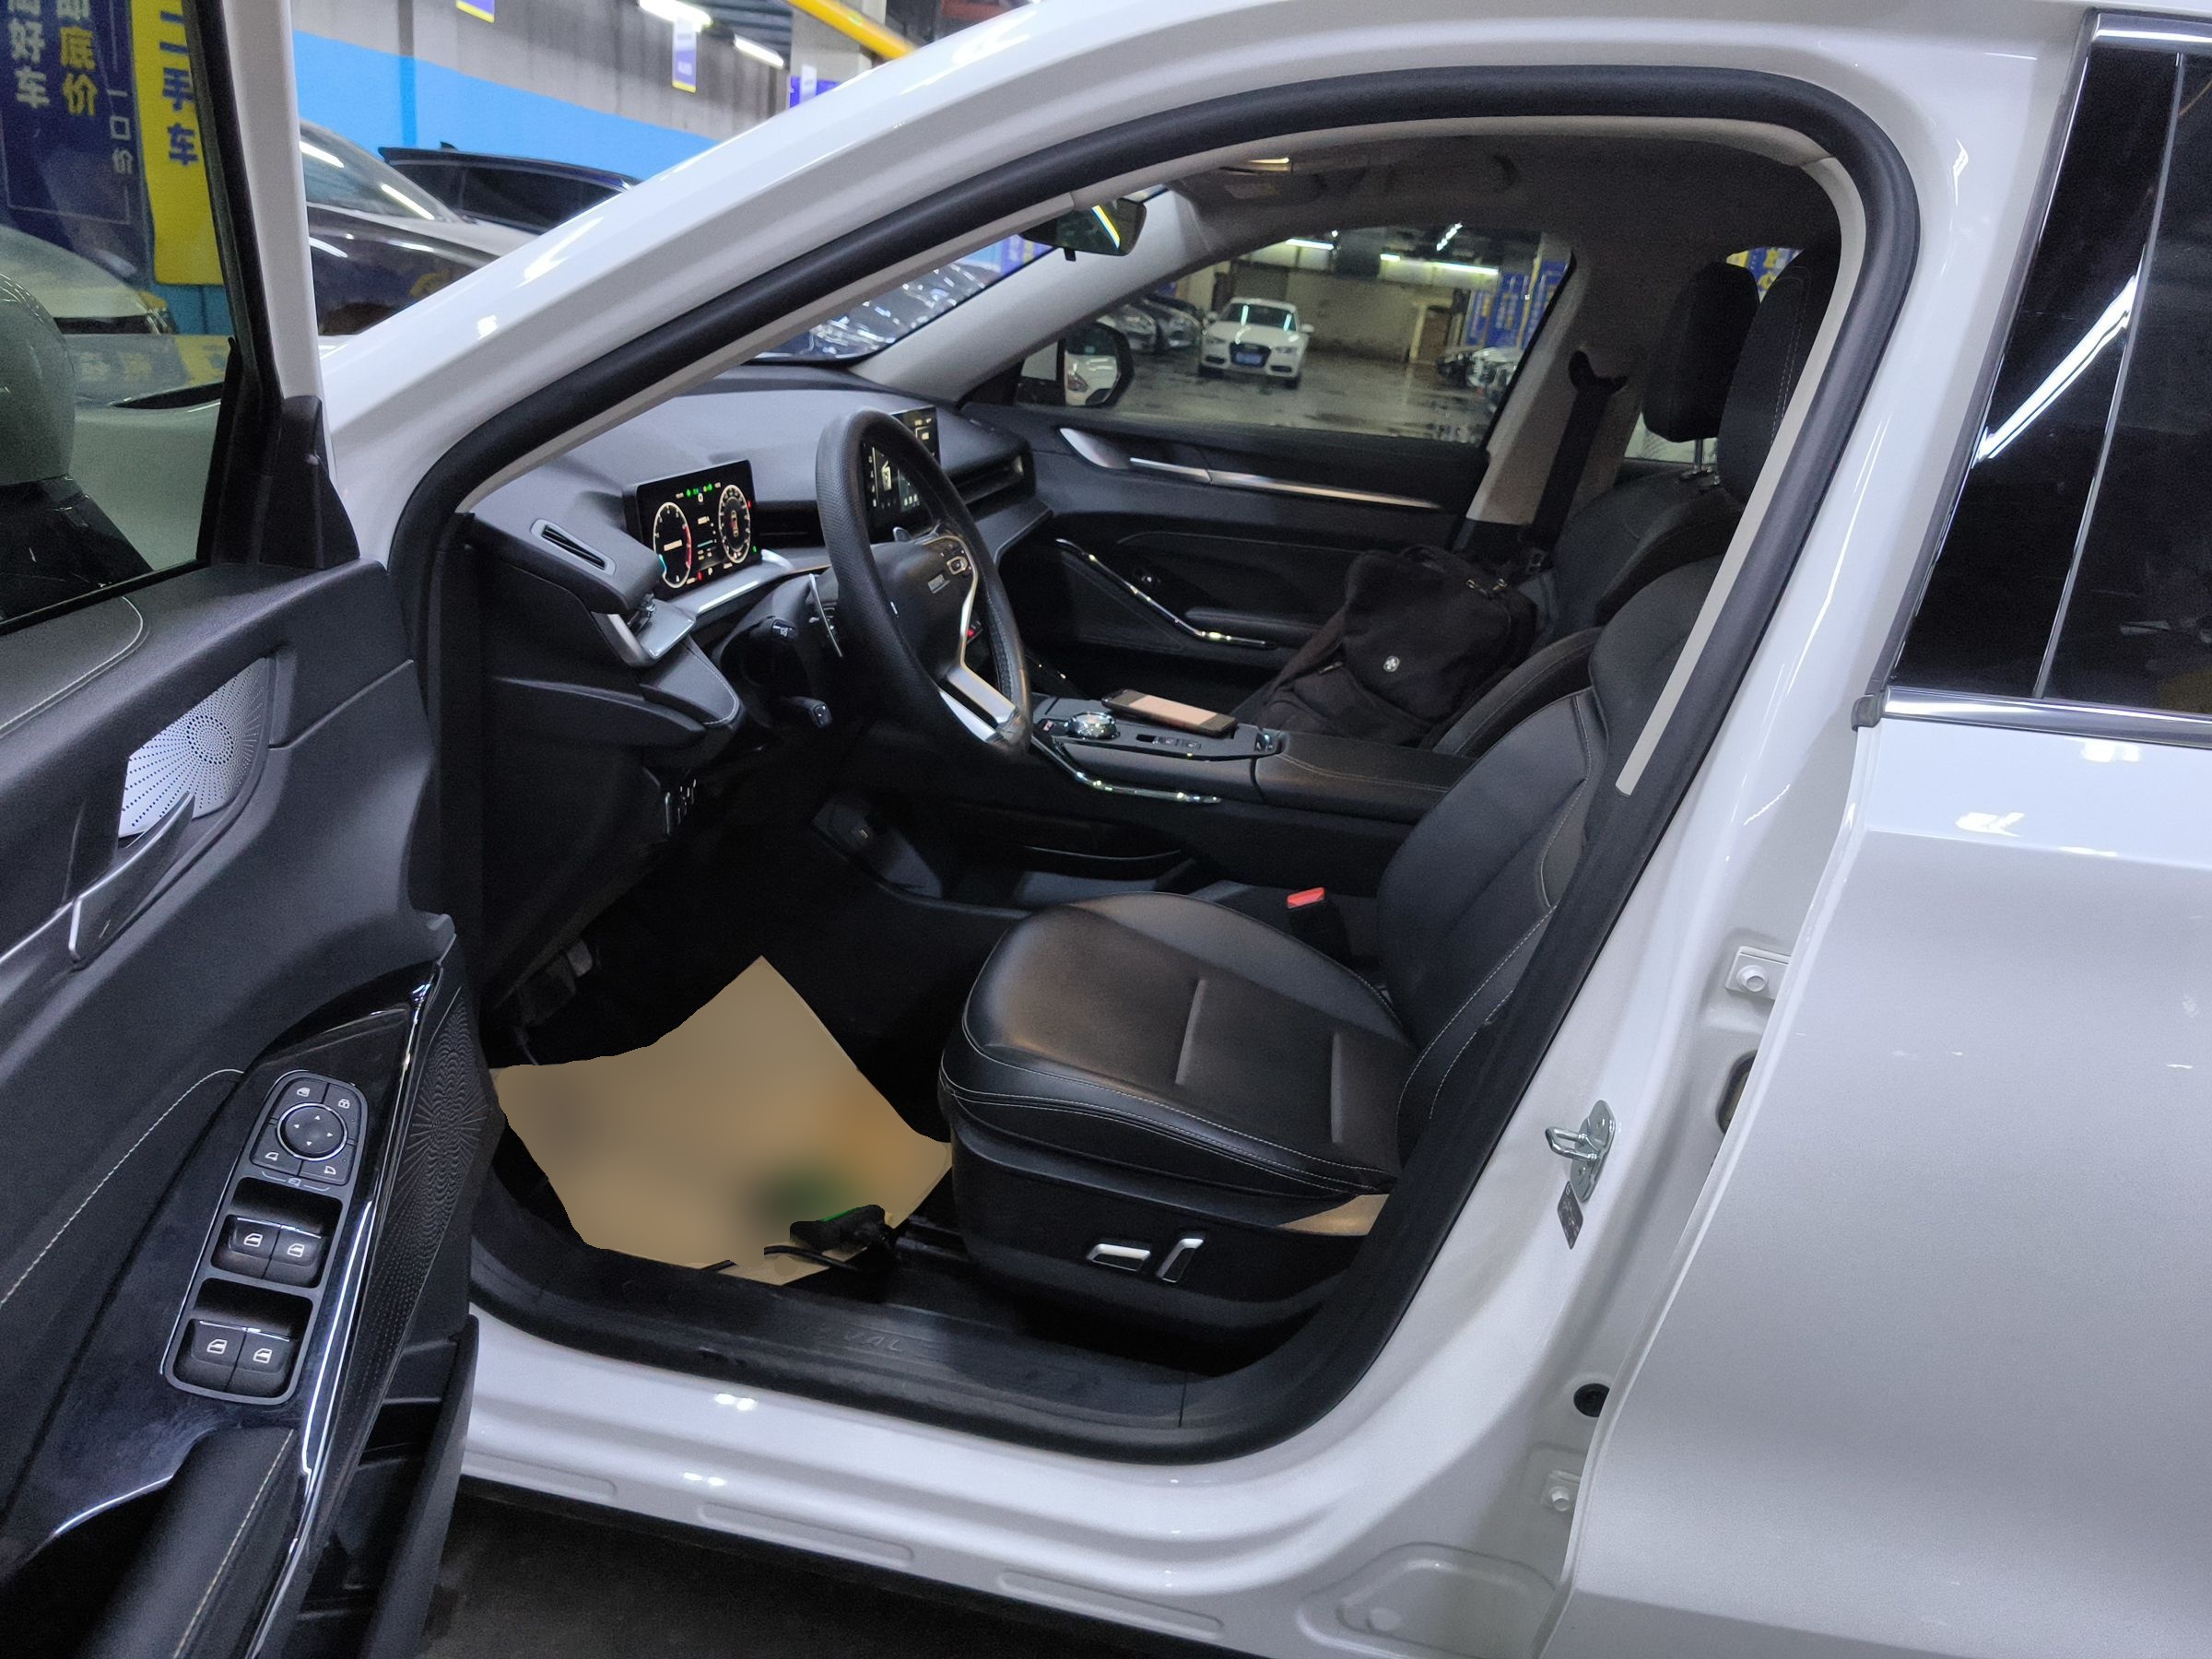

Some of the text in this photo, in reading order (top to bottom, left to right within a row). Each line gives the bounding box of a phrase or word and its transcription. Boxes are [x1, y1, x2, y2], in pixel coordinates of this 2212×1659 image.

[107, 88, 133, 174] 一口价
[159, 11, 198, 166] 二手车
